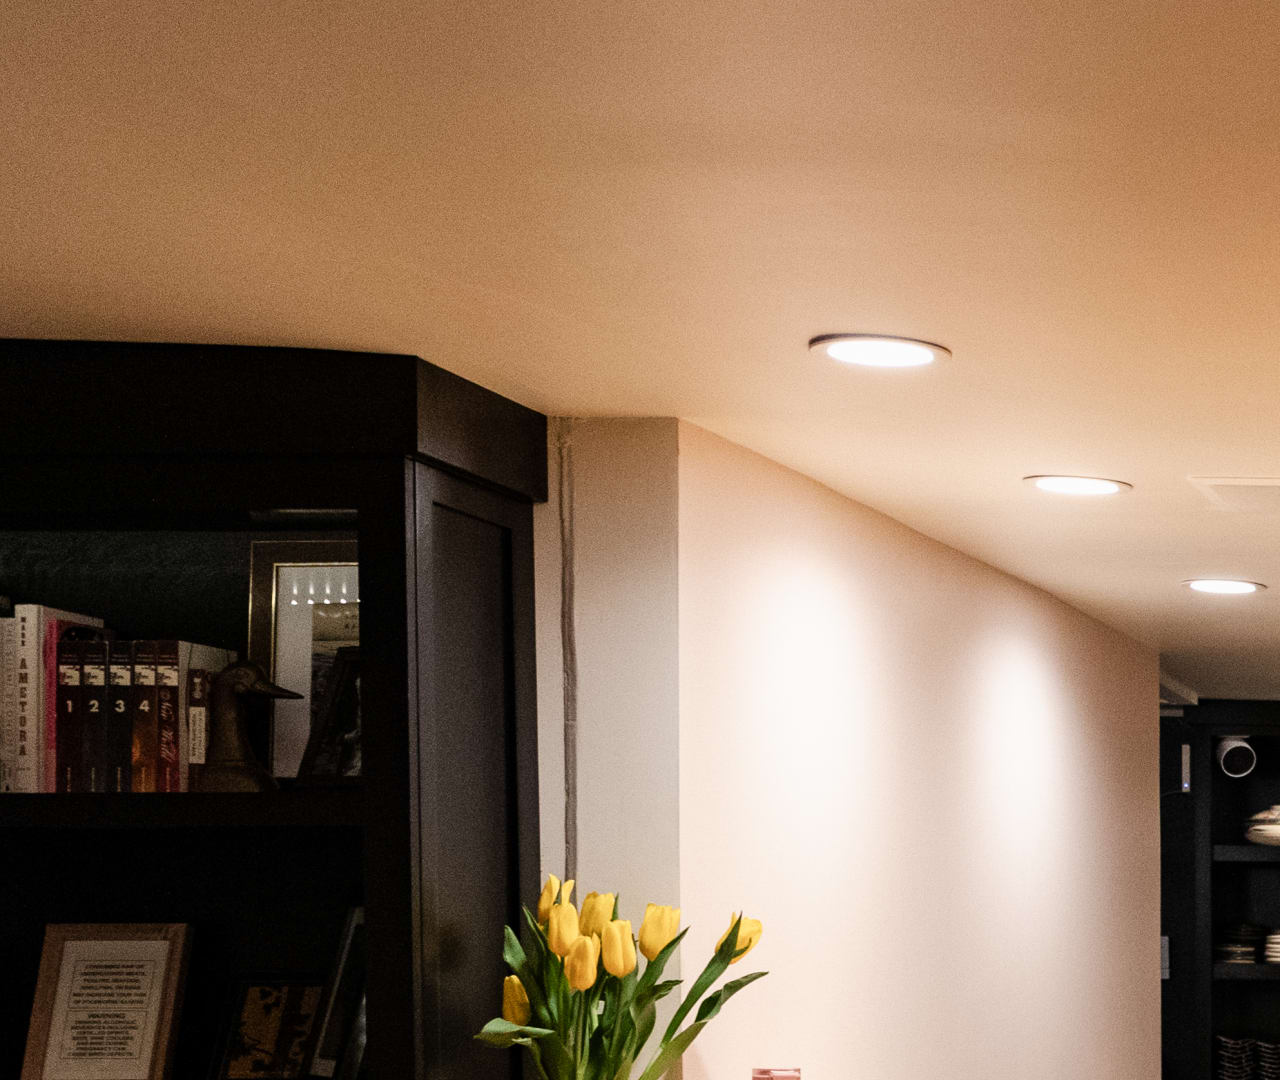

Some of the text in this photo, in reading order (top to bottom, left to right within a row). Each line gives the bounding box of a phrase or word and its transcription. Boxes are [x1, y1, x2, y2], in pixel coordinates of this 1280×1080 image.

[19, 657, 28, 756] AMETORA
[66, 699, 73, 713] 1
[88, 699, 100, 713] 2
[114, 699, 126, 714] 3
[138, 699, 151, 713] 4
